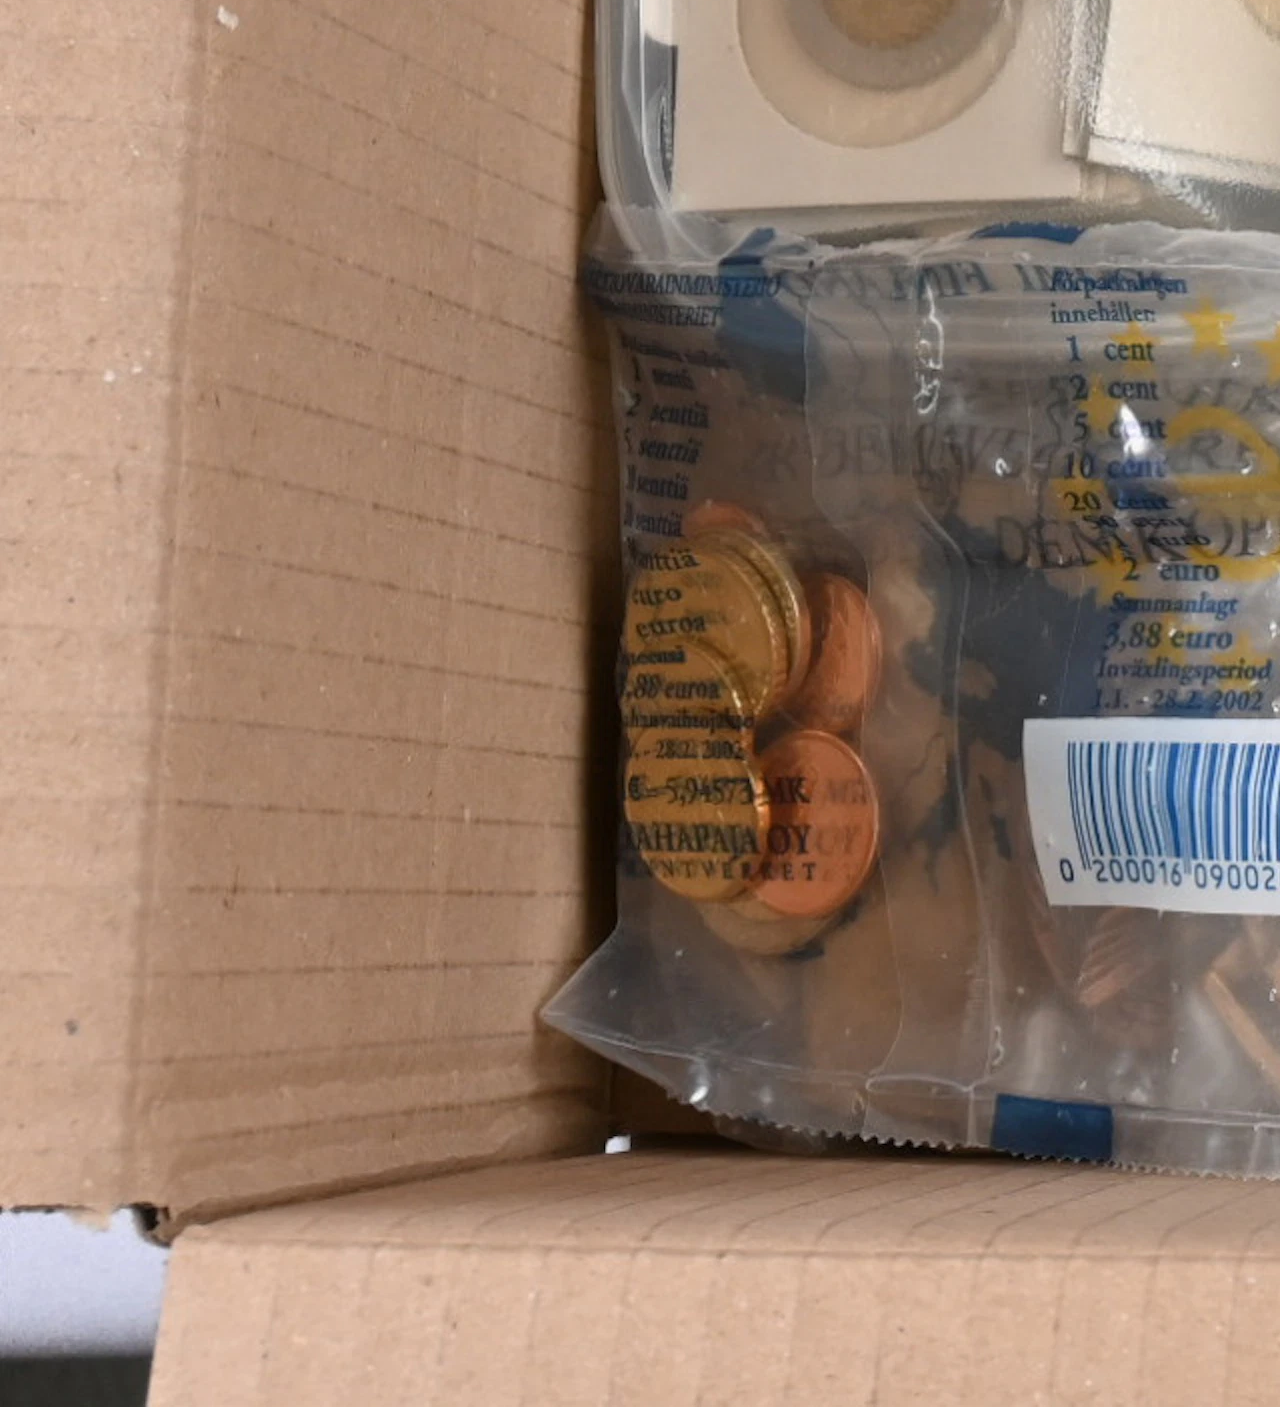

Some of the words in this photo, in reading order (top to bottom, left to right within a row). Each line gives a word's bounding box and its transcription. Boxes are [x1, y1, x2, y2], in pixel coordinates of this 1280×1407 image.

[1051, 301, 1157, 324] innehåller:
[1065, 334, 1082, 363] 1
[1104, 341, 1156, 362] cent
[1069, 374, 1089, 402] 2
[1107, 378, 1160, 401] cent
[1072, 411, 1090, 443] 5
[1107, 417, 1169, 440] cnt
[1063, 451, 1096, 480] 10
[1063, 491, 1102, 512] 20
[1122, 555, 1142, 582] 2
[1159, 562, 1221, 583] euro
[1103, 621, 1163, 653] 3,88
[1170, 628, 1234, 650] euro
[1212, 689, 1265, 712] 2002
[1060, 858, 1076, 884] 0
[1095, 857, 1183, 887] 200016
